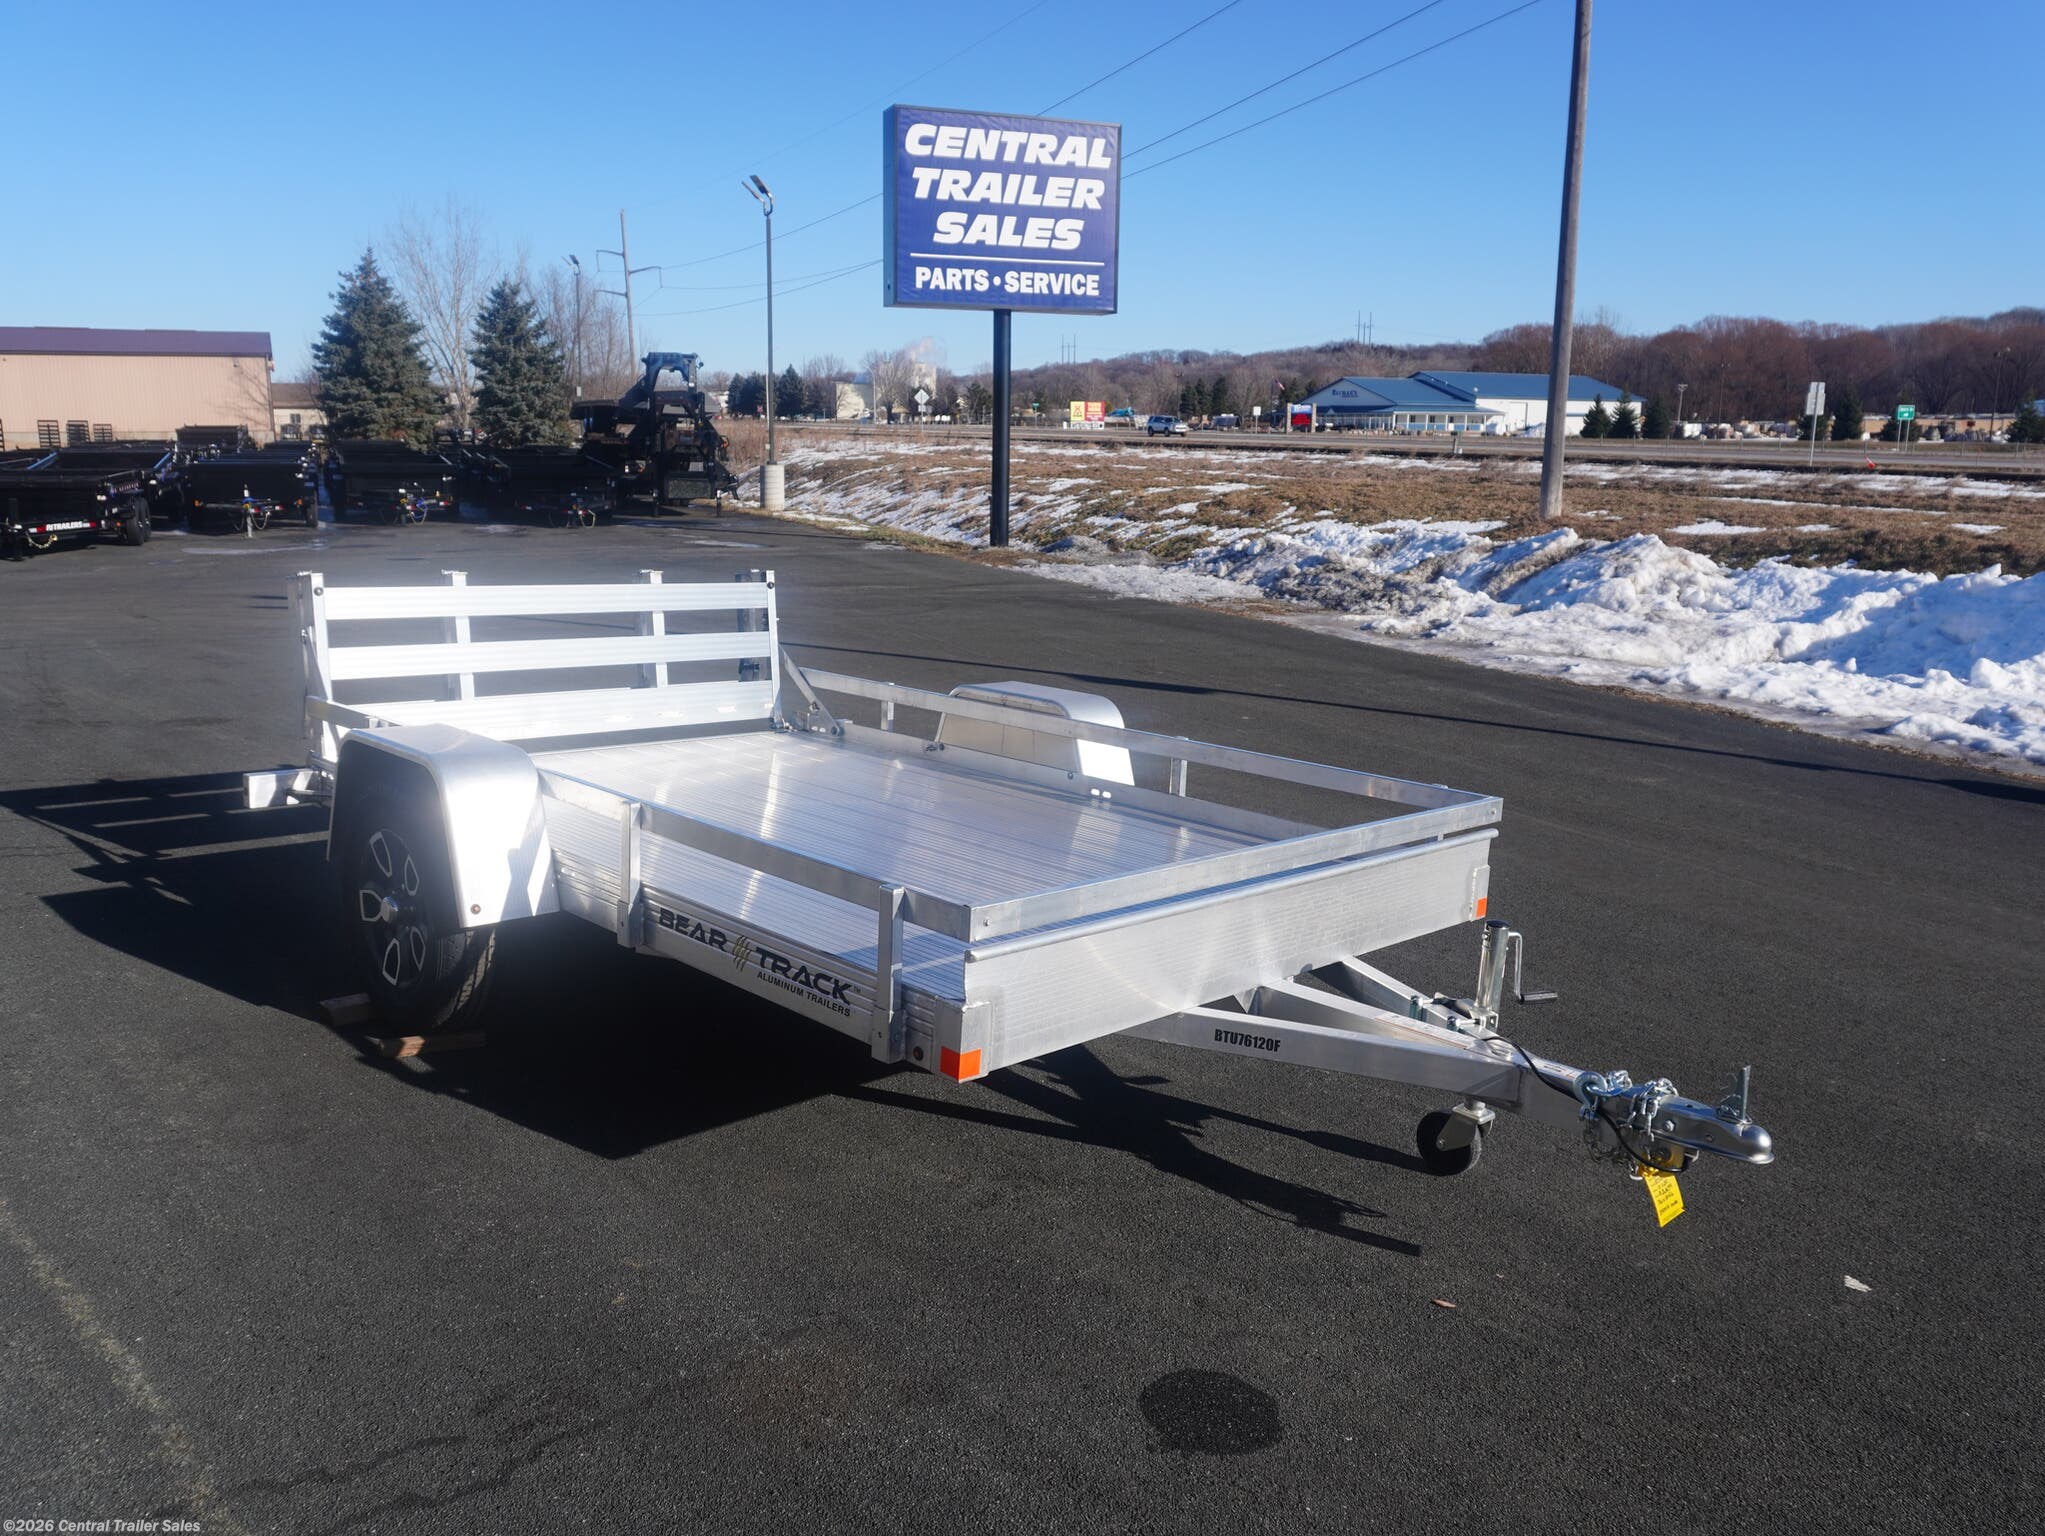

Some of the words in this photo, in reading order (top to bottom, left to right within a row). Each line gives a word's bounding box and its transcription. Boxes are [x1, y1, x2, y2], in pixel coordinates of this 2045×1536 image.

[905, 123, 1112, 169] CENTRAL
[912, 167, 1105, 210] TRAILER
[933, 211, 1085, 250] SALES
[915, 266, 990, 292] PARTS
[1004, 270, 1100, 296] SERVICE
[659, 907, 729, 952] BEAR
[755, 946, 853, 1005] TRACK
[756, 971, 804, 997] ALUMINUM
[806, 991, 851, 1017] TRAILERS
[1214, 1028, 1281, 1052] BTU76120F
